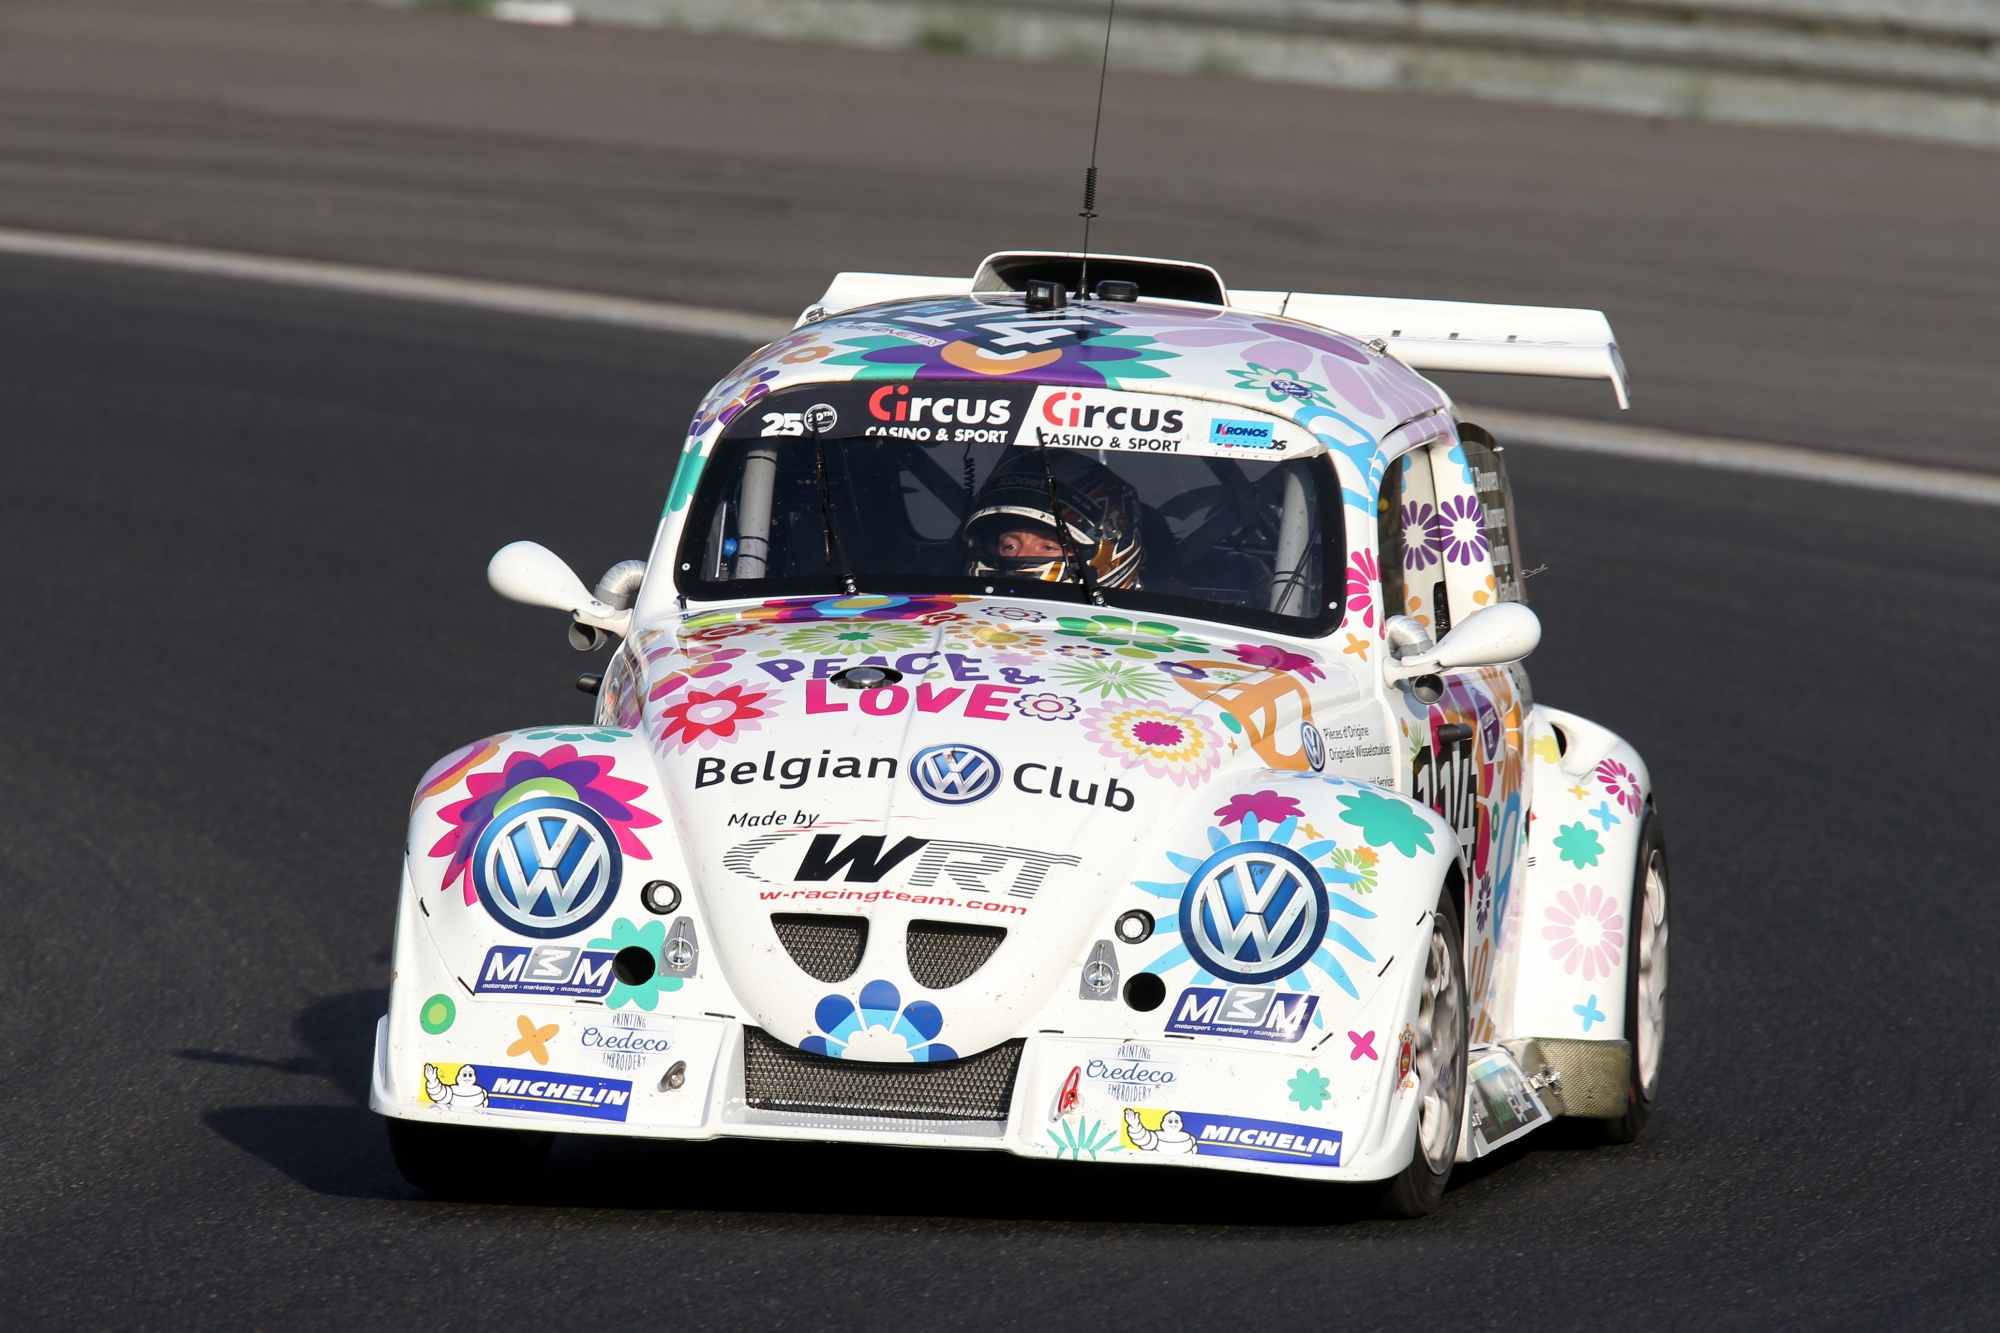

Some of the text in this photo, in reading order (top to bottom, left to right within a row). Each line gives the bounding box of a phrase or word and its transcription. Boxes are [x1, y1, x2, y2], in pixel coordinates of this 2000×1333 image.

[868, 385, 1012, 425] Circus
[1042, 391, 1184, 433] Circus
[865, 426, 1009, 444] CASINO & SPORT
[1215, 420, 1270, 438] KRONOS
[1040, 433, 1182, 452] CASINO & SPORT
[999, 667, 1046, 685] &
[806, 679, 1022, 722] LOVE
[694, 749, 898, 790] Belgian
[1012, 761, 1136, 813] Club
[727, 810, 820, 830] Made by
[793, 833, 1082, 899] WRT
[759, 888, 1027, 916] w-racingteam.com
[612, 1013, 646, 1028] PRINTING
[581, 1027, 671, 1052] Credeco
[602, 1052, 646, 1071] EMBROIDERY
[1117, 1044, 1151, 1060] PRINTING
[1086, 1059, 1177, 1083] Credeco
[491, 1077, 630, 1106] MICHELIN
[1108, 1083, 1152, 1102] EMBROIDERY
[1200, 1124, 1340, 1157] MICHELIN
